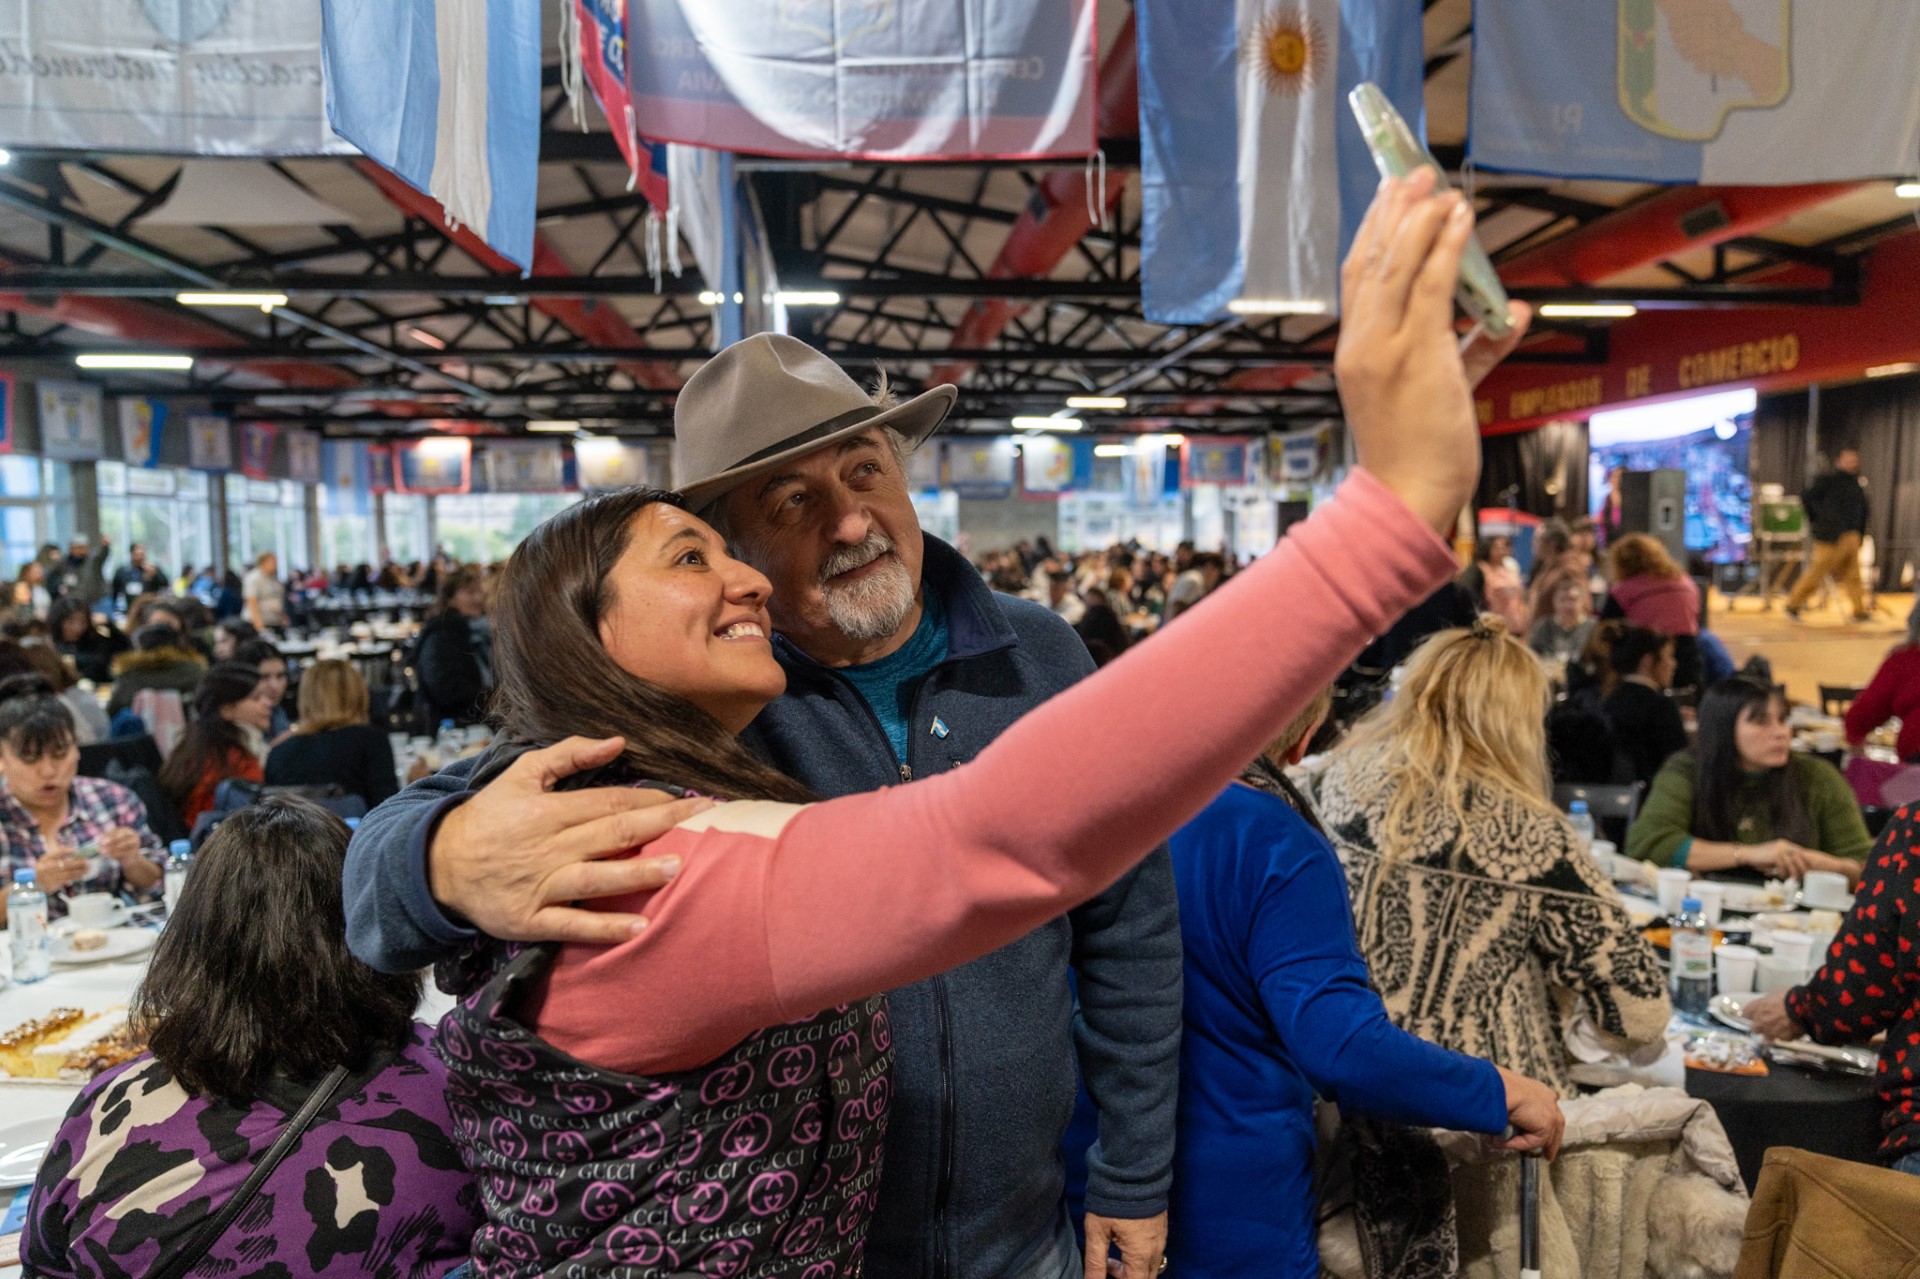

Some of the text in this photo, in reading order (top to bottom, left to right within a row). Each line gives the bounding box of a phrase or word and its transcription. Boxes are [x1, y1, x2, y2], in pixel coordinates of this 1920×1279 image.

[1626, 364, 1651, 397] DE
[1678, 334, 1799, 388] COMERCIO
[771, 1024, 823, 1048] GUCCI
[829, 1008, 859, 1036] GUCCI
[578, 1162, 636, 1180] GUCCI
[677, 1162, 737, 1186] GUCCI
[748, 1149, 804, 1175] GUCCI
[623, 1209, 668, 1226] UCCI
[700, 1221, 762, 1243] GUCCI
